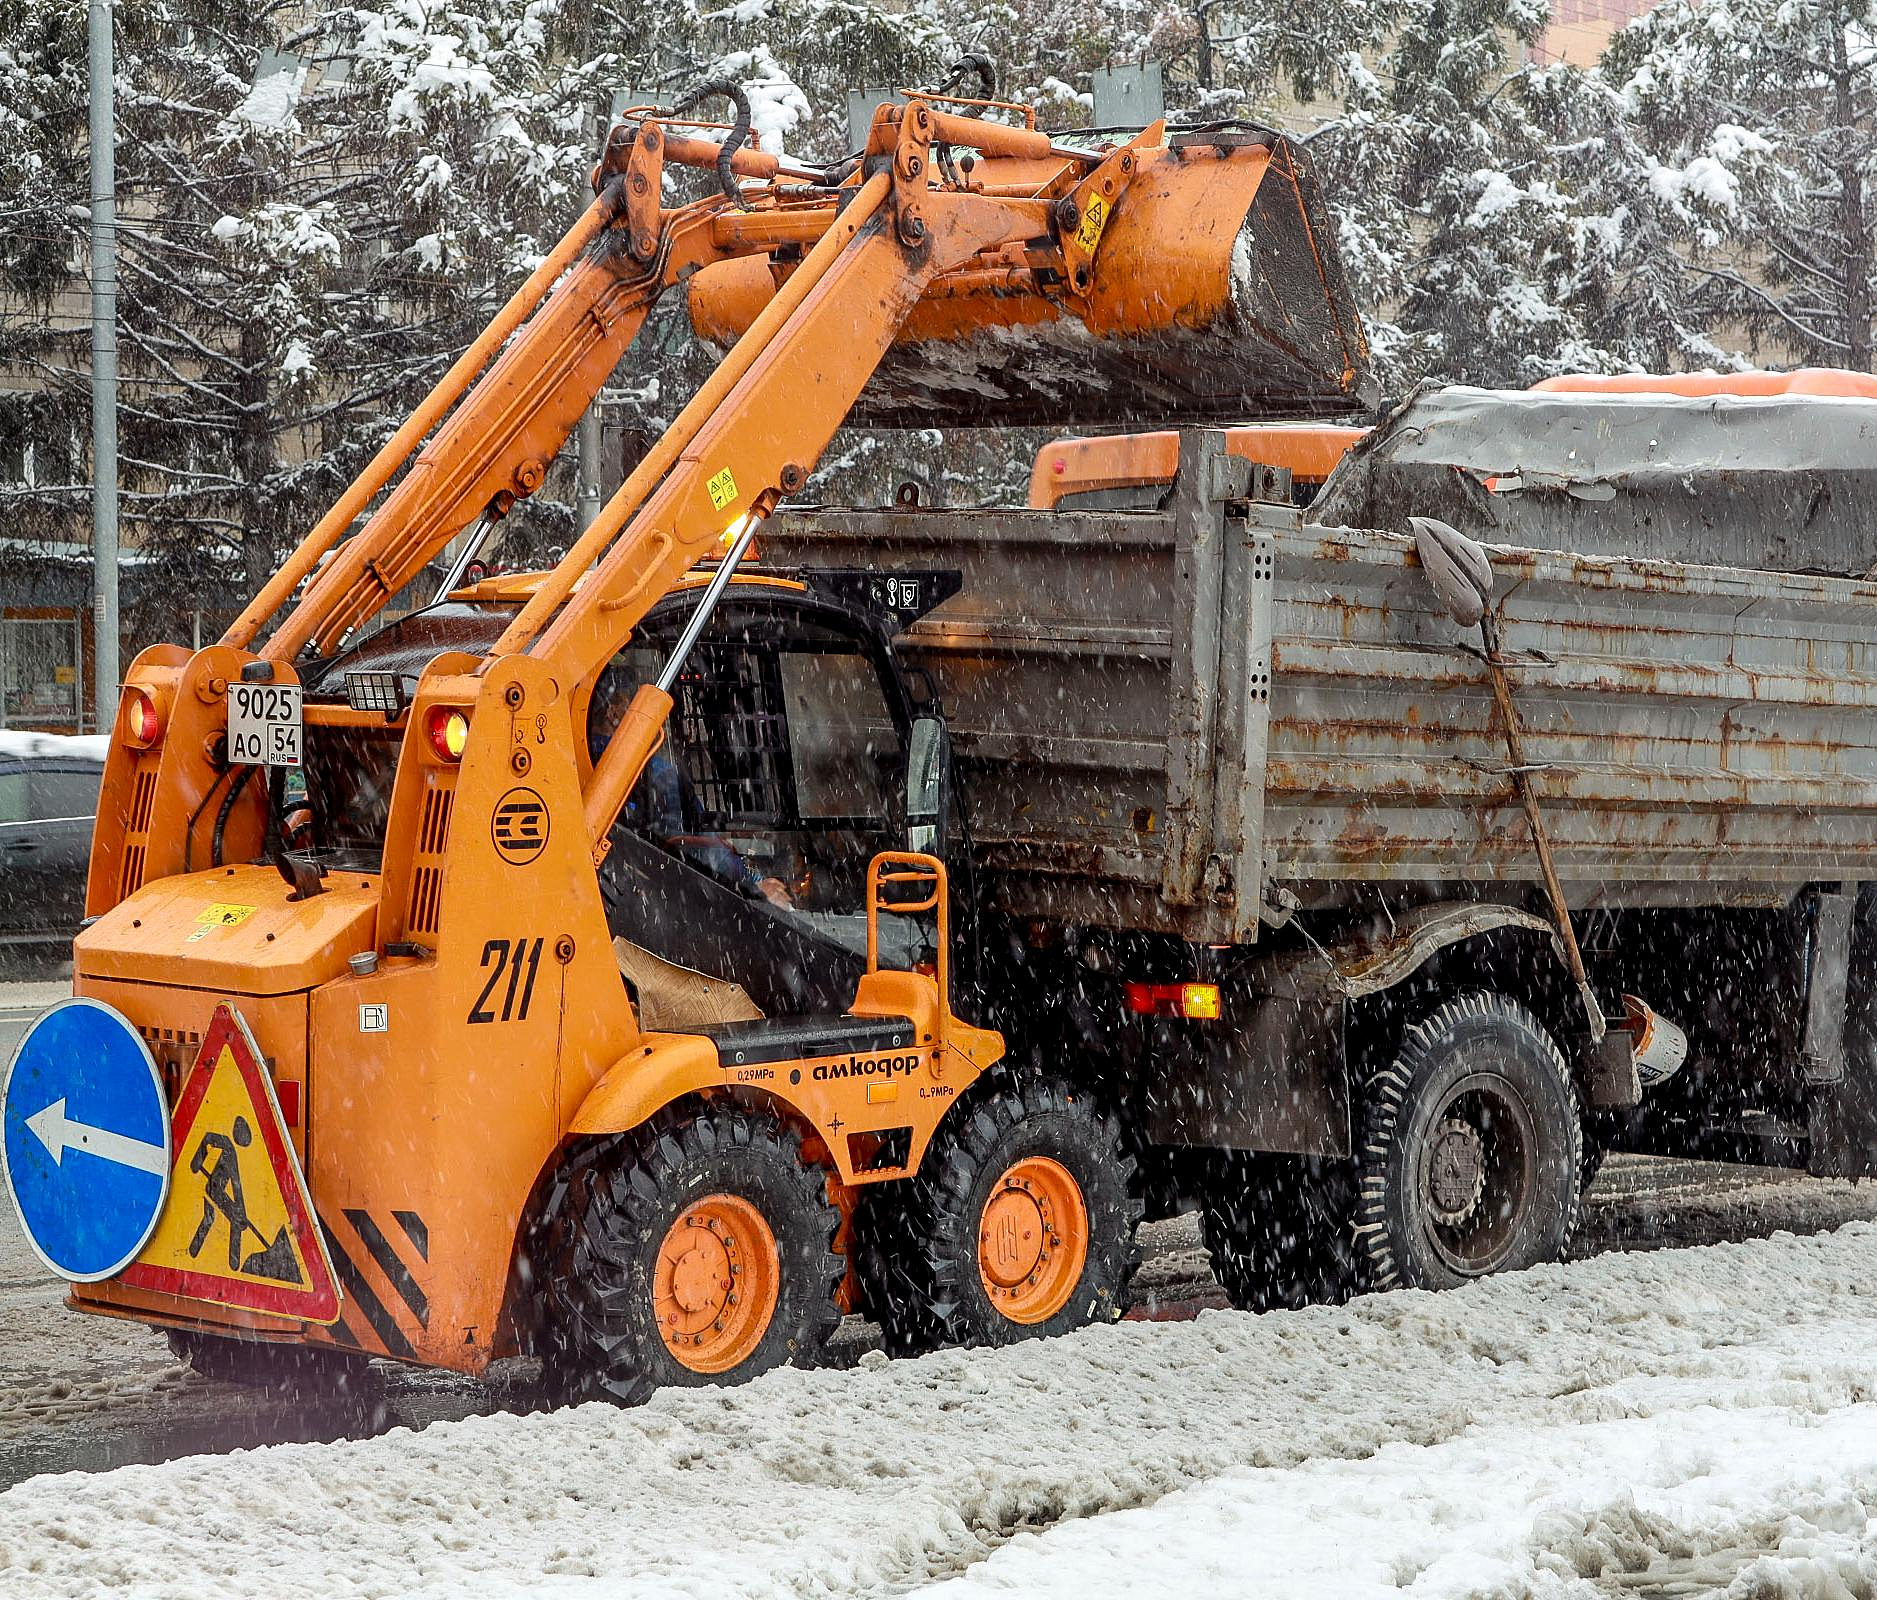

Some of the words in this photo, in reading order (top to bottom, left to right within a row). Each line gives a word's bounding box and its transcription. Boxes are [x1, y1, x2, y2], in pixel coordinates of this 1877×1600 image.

[237, 687, 293, 721] 9025
[274, 727, 296, 753] 54
[270, 752, 287, 763] RUS
[466, 937, 544, 1025] 211
[737, 1068, 774, 1083] 0,29MPa
[919, 1085, 954, 1100] 0,9MPa
